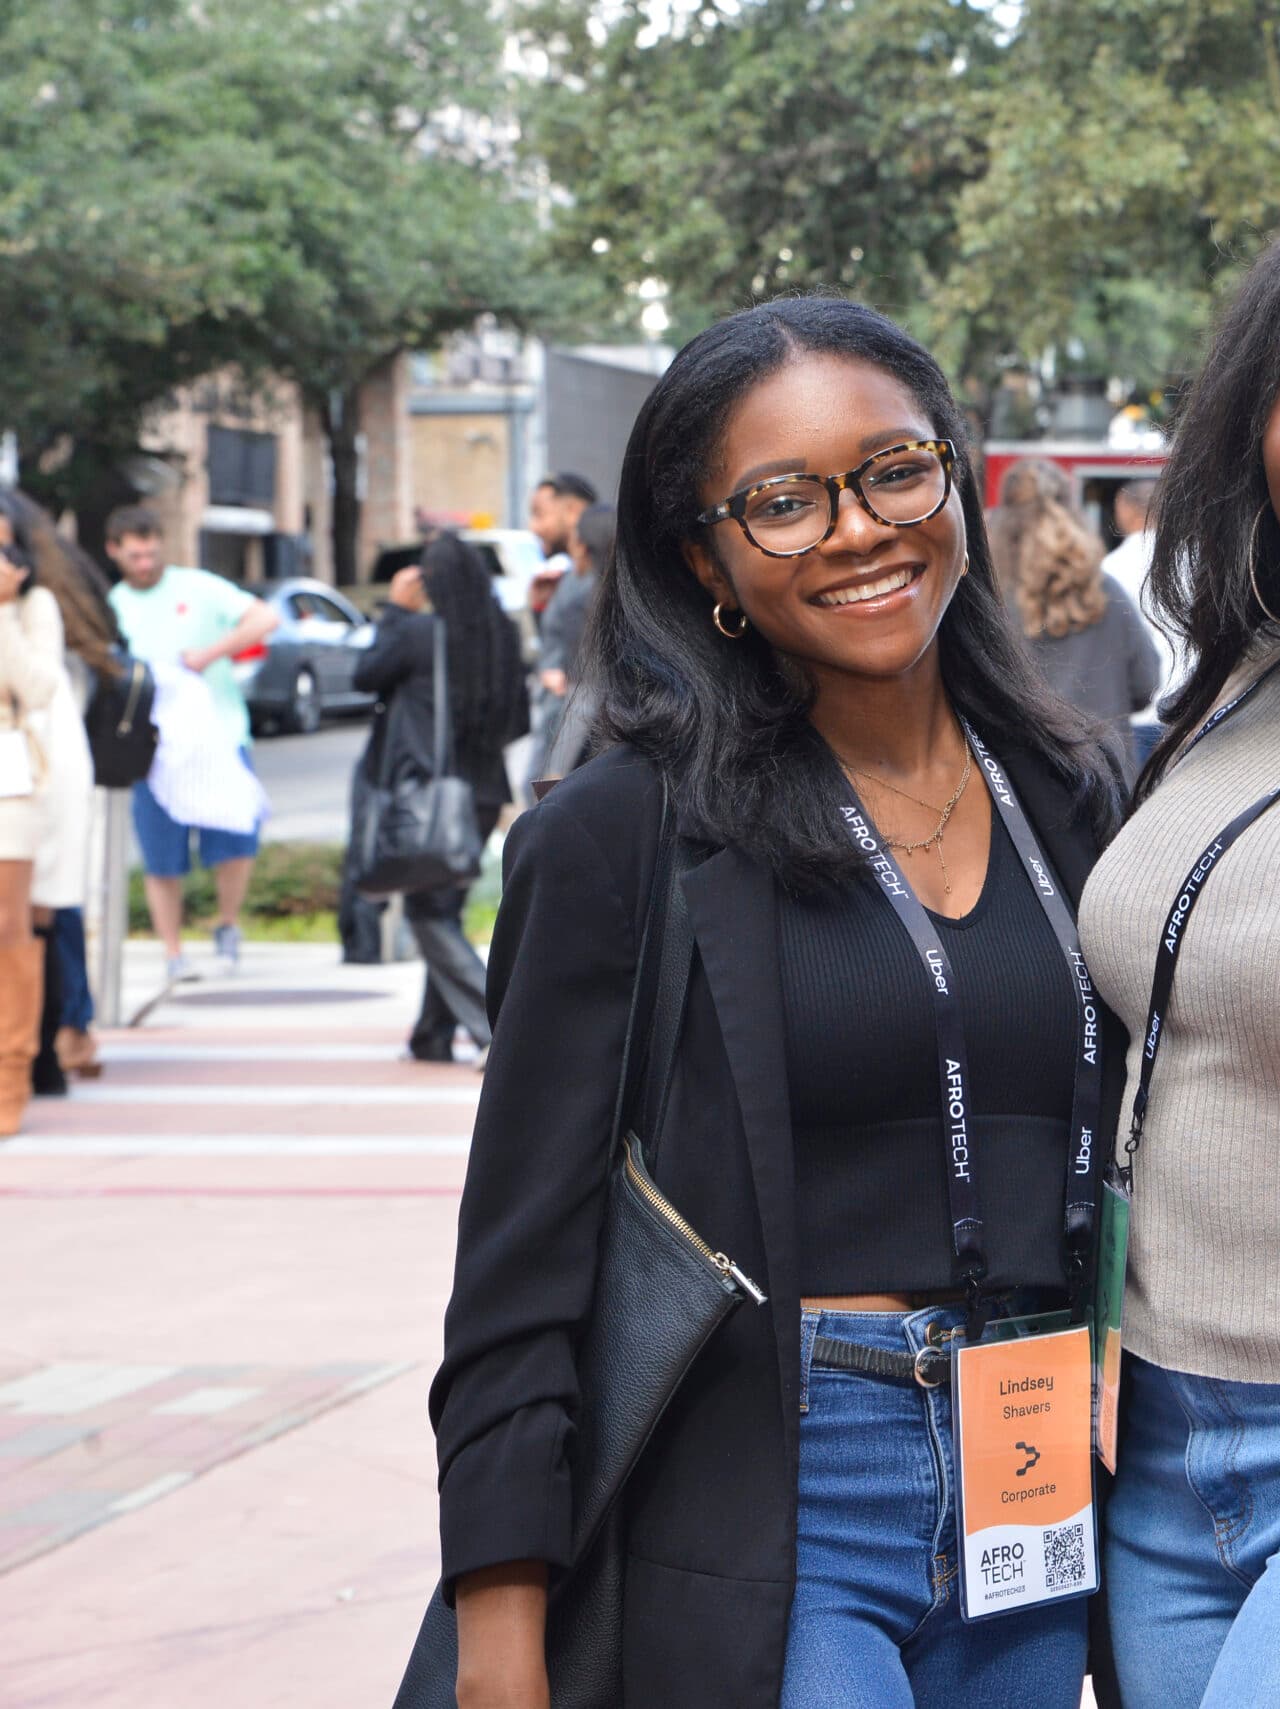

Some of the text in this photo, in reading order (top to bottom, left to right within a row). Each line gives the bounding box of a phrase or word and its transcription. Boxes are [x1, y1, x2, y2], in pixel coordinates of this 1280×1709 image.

[840, 806, 909, 899] AFROTECH
[1028, 856, 1054, 896] Uber
[1165, 837, 1222, 954] AFROTECH
[926, 949, 949, 995] Uber
[1068, 946, 1097, 1065] AFROTECH
[1145, 1010, 1161, 1059] Uber
[945, 1058, 971, 1183] AFROTECH
[1075, 1126, 1093, 1174] Uber
[1000, 1376, 1055, 1396] Lindsey
[1003, 1402, 1051, 1419] Shavers
[1001, 1483, 1056, 1503] Corporate
[980, 1542, 1024, 1567] AFRO
[981, 1561, 1025, 1585] TECH
[984, 1585, 1026, 1600] #AFROTECH23
